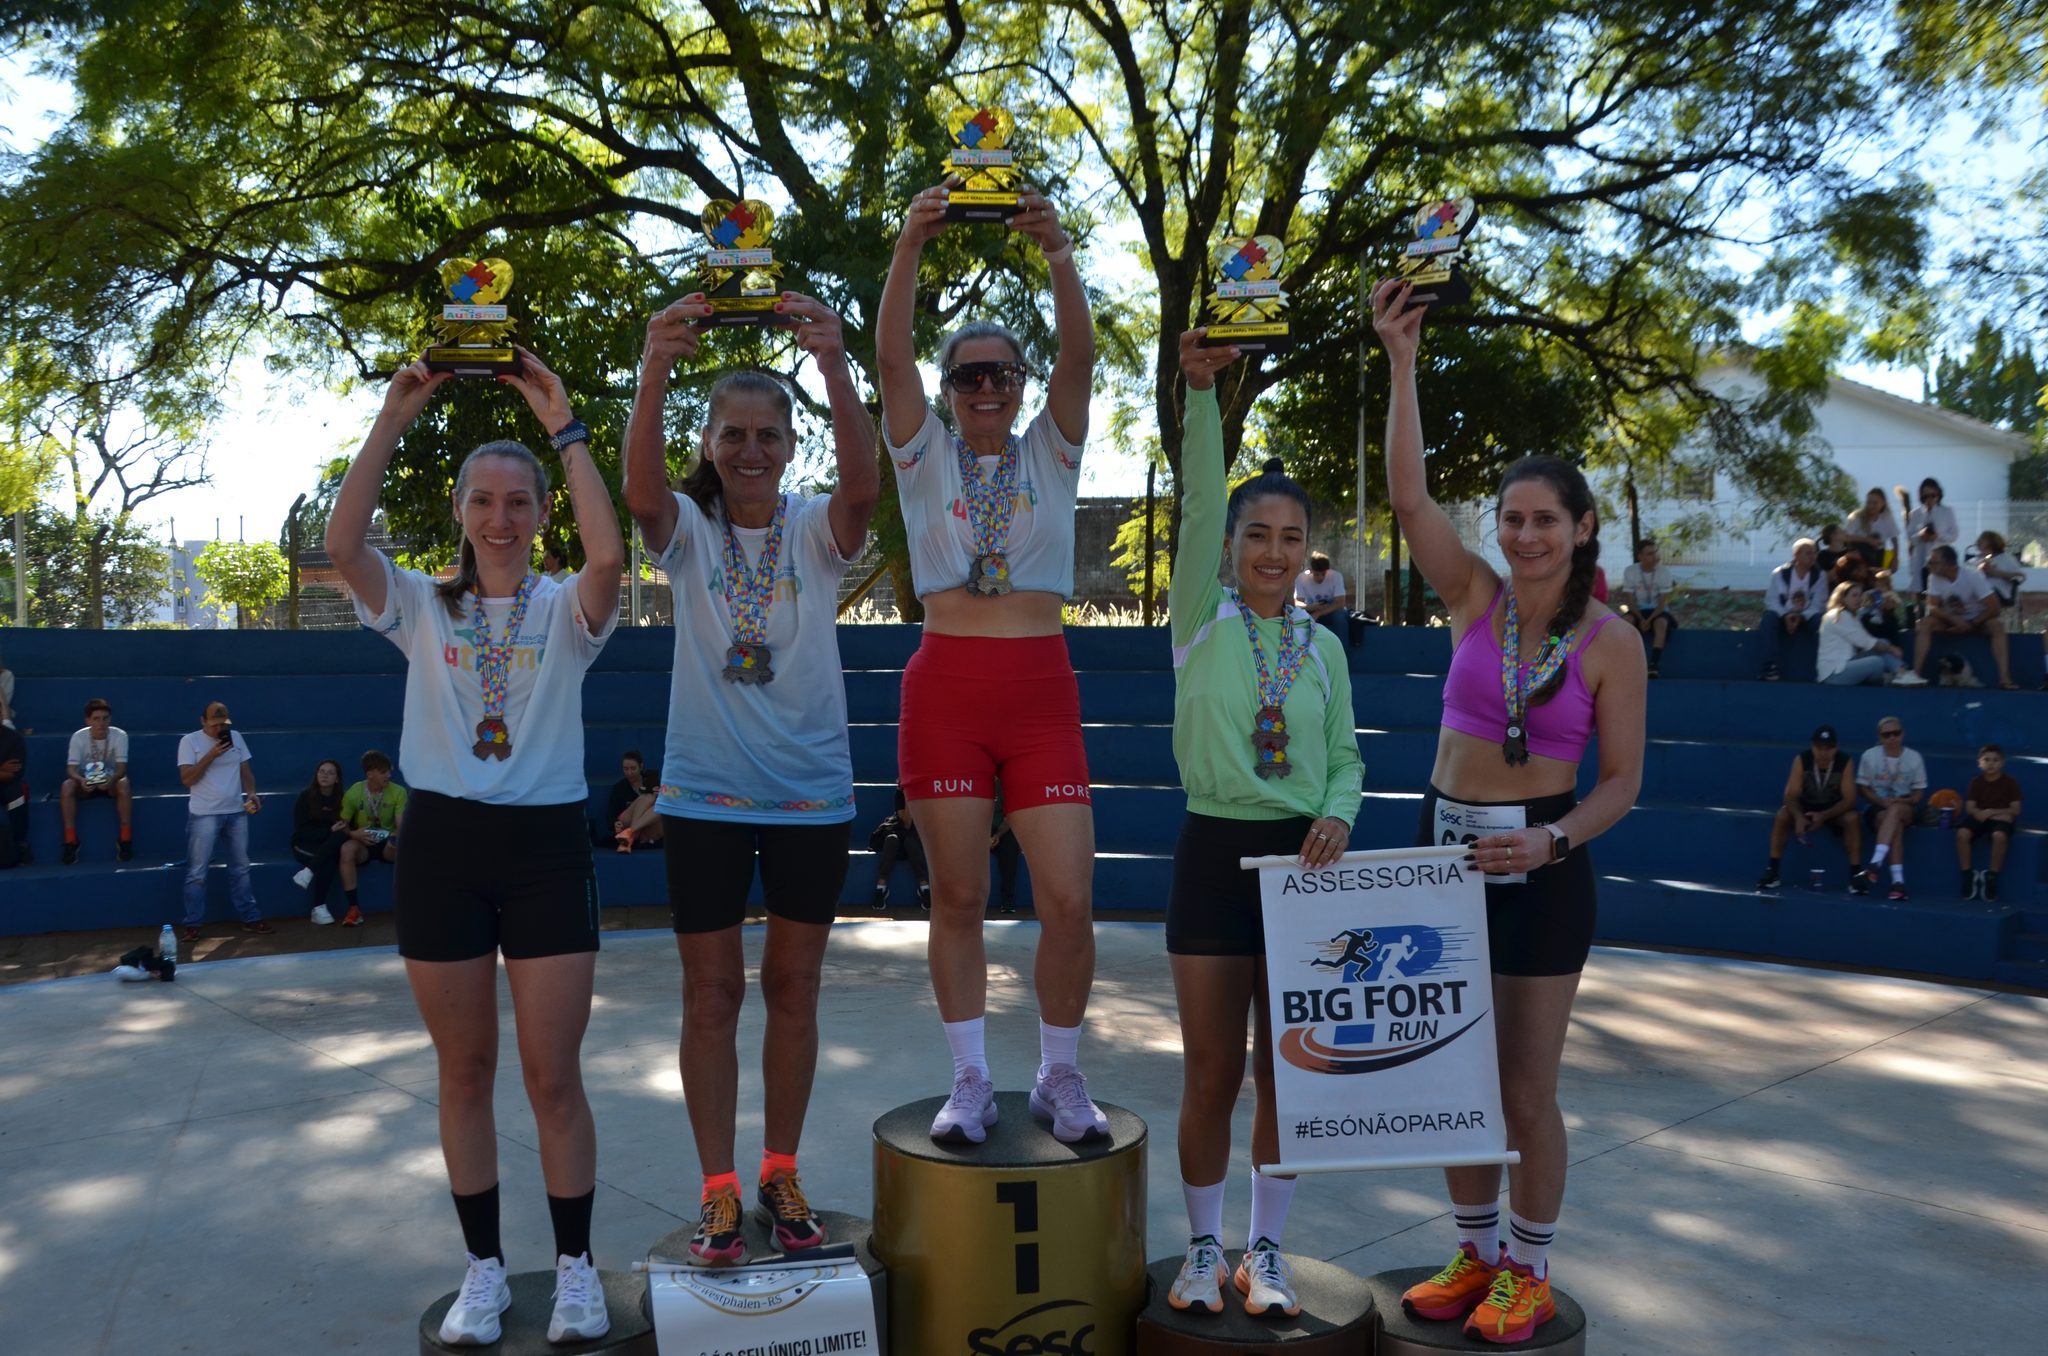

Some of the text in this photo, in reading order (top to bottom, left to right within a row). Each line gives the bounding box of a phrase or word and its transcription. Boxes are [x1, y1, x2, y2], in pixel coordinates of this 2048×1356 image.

[446, 311, 505, 319] Autismo
[933, 779, 1091, 799] RUN MORE
[1282, 863, 1463, 895] ASSESSORIA
[1282, 980, 1468, 1024] BIG FORT
[1388, 1020, 1439, 1043] RUN
[1295, 1110, 1486, 1140] #ÉSÓNÃOPARAR
[996, 1181, 1040, 1295] 1
[769, 1339, 811, 1356] ÚNICO
[815, 1330, 867, 1354] LIMITE!
